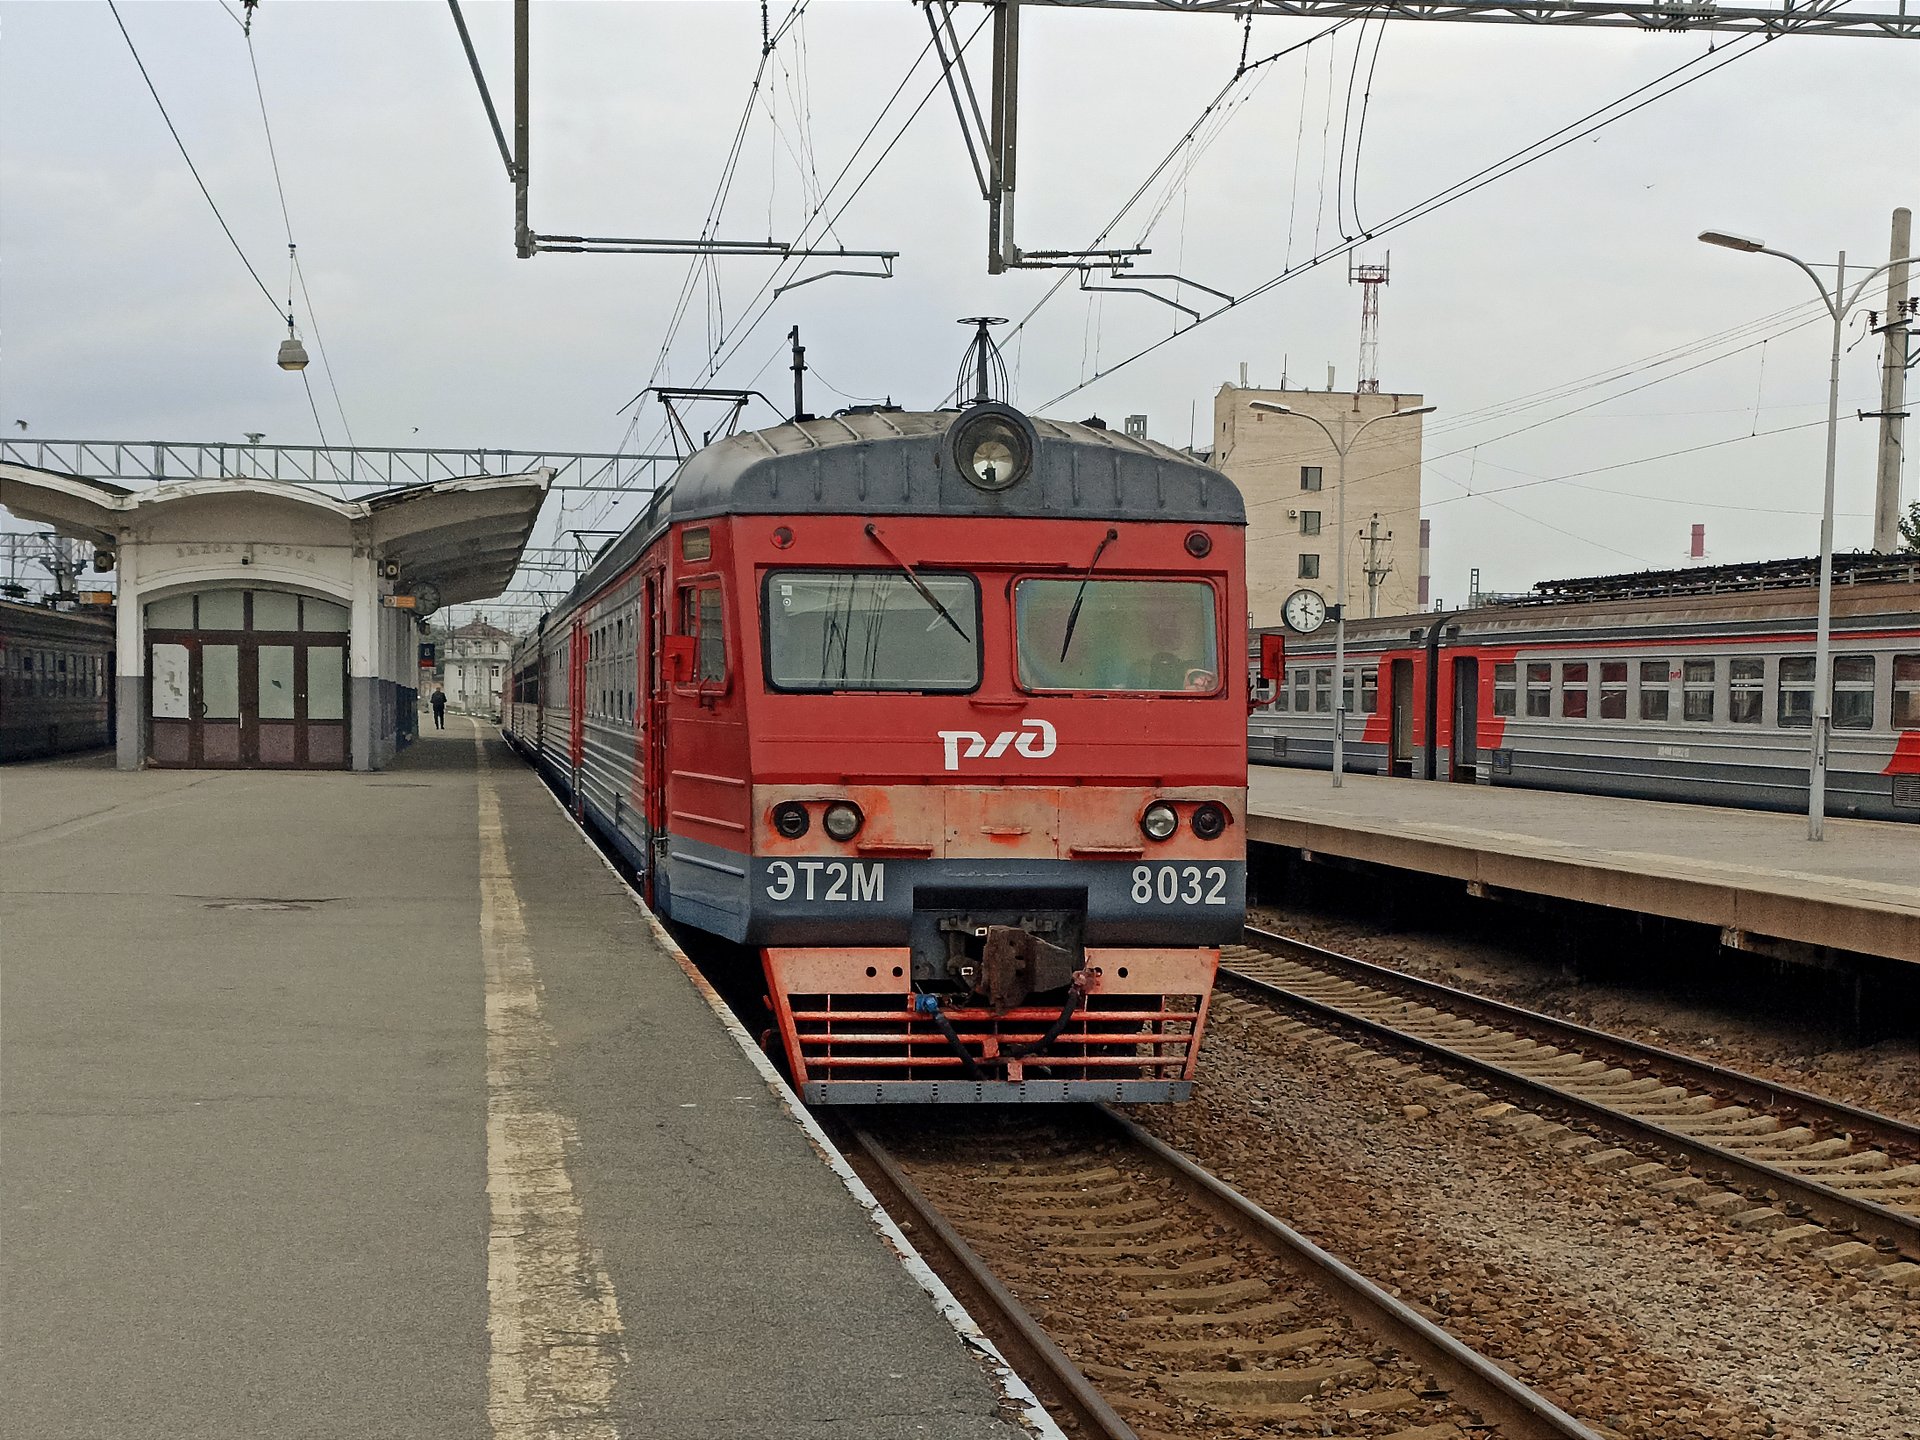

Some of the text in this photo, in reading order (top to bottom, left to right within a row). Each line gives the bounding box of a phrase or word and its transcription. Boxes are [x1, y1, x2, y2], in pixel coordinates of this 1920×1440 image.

[938, 719, 1057, 770] РЖД
[766, 861, 885, 901] ЭТ2М
[1131, 865, 1227, 905] 8032
